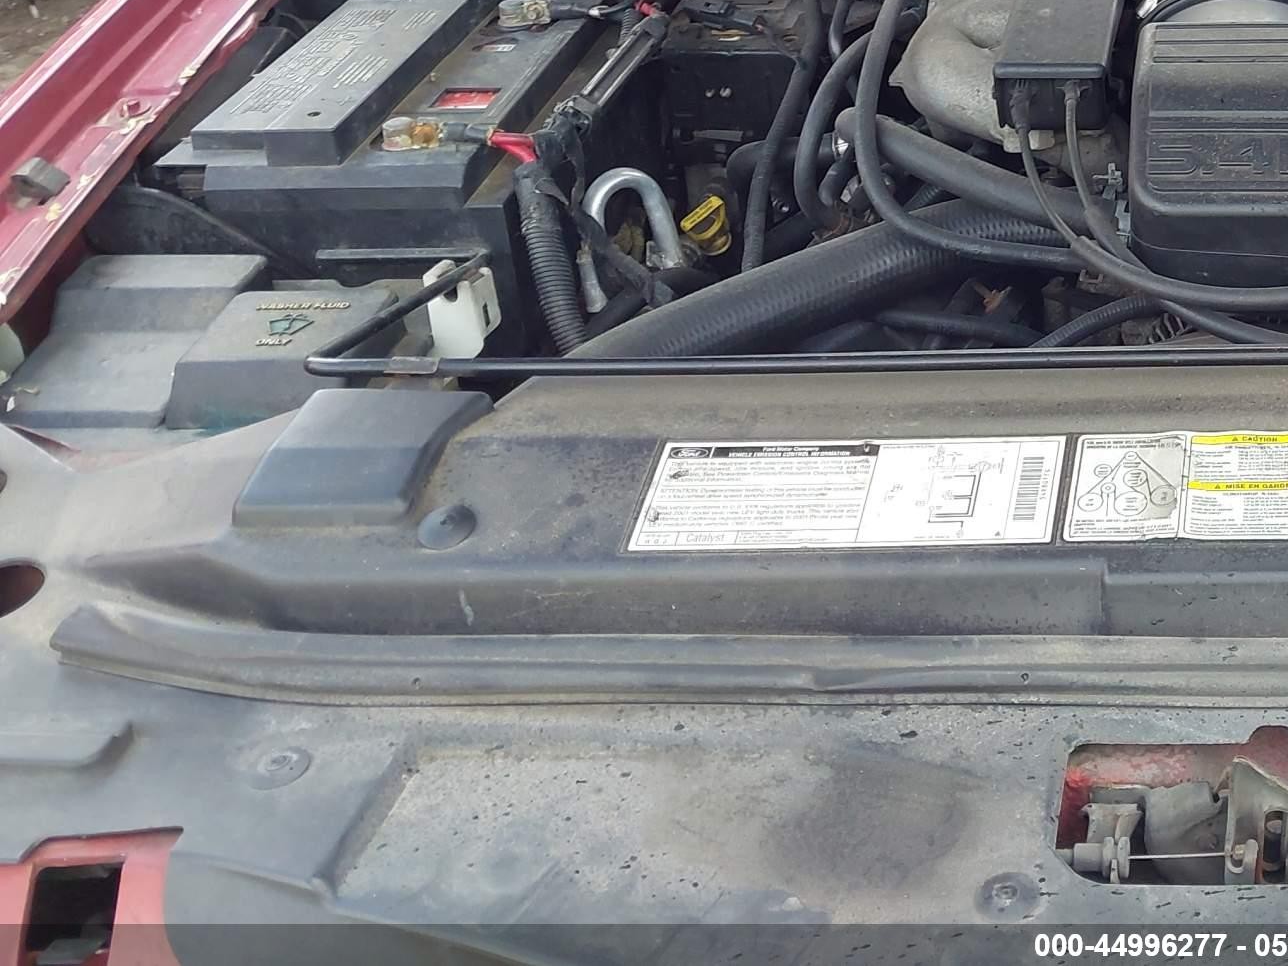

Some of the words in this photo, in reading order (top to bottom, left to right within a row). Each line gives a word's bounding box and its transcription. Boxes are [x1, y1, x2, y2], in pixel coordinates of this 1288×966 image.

[256, 302, 310, 311] WASHER
[313, 301, 351, 310] FLUID
[256, 338, 292, 346] ONLY
[686, 532, 725, 544] Catalyst
